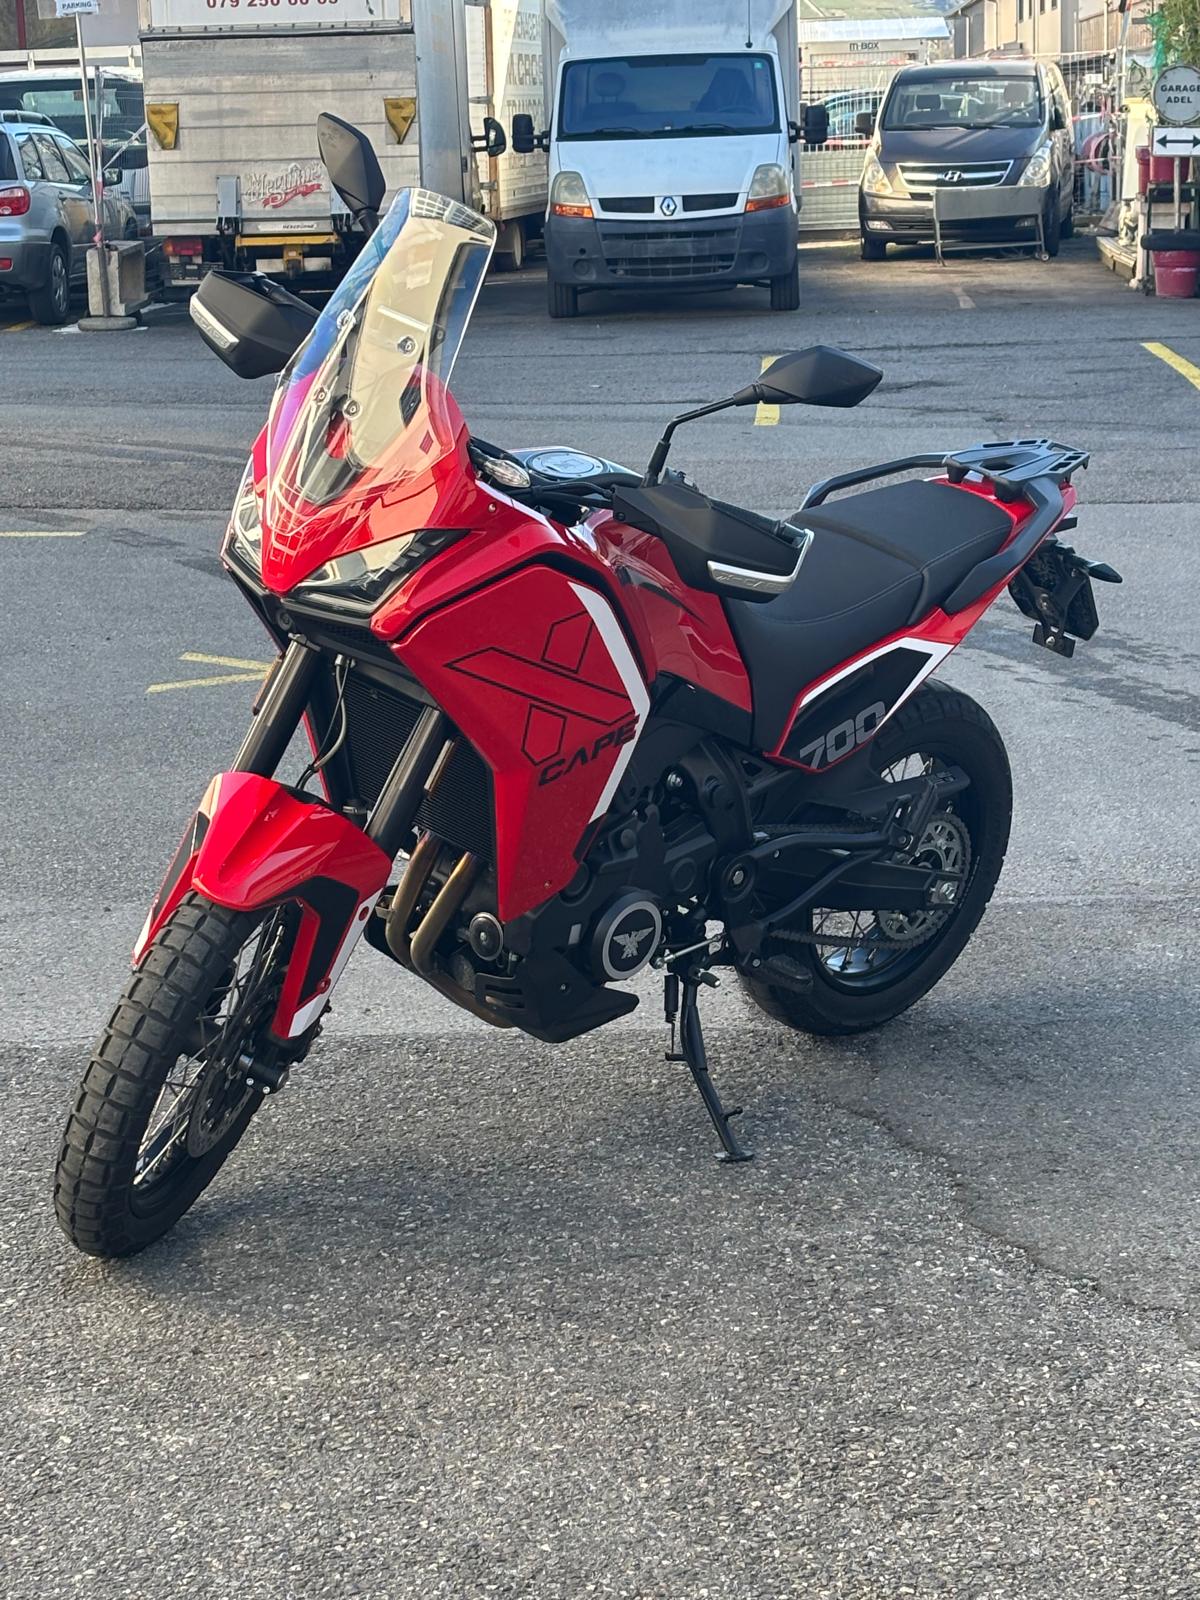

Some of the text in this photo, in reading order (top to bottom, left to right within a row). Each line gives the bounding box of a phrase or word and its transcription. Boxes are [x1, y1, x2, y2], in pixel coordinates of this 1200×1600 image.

[1166, 96, 1193, 104] ADEL
[538, 714, 641, 786] CAPE
[799, 701, 886, 769] 700
